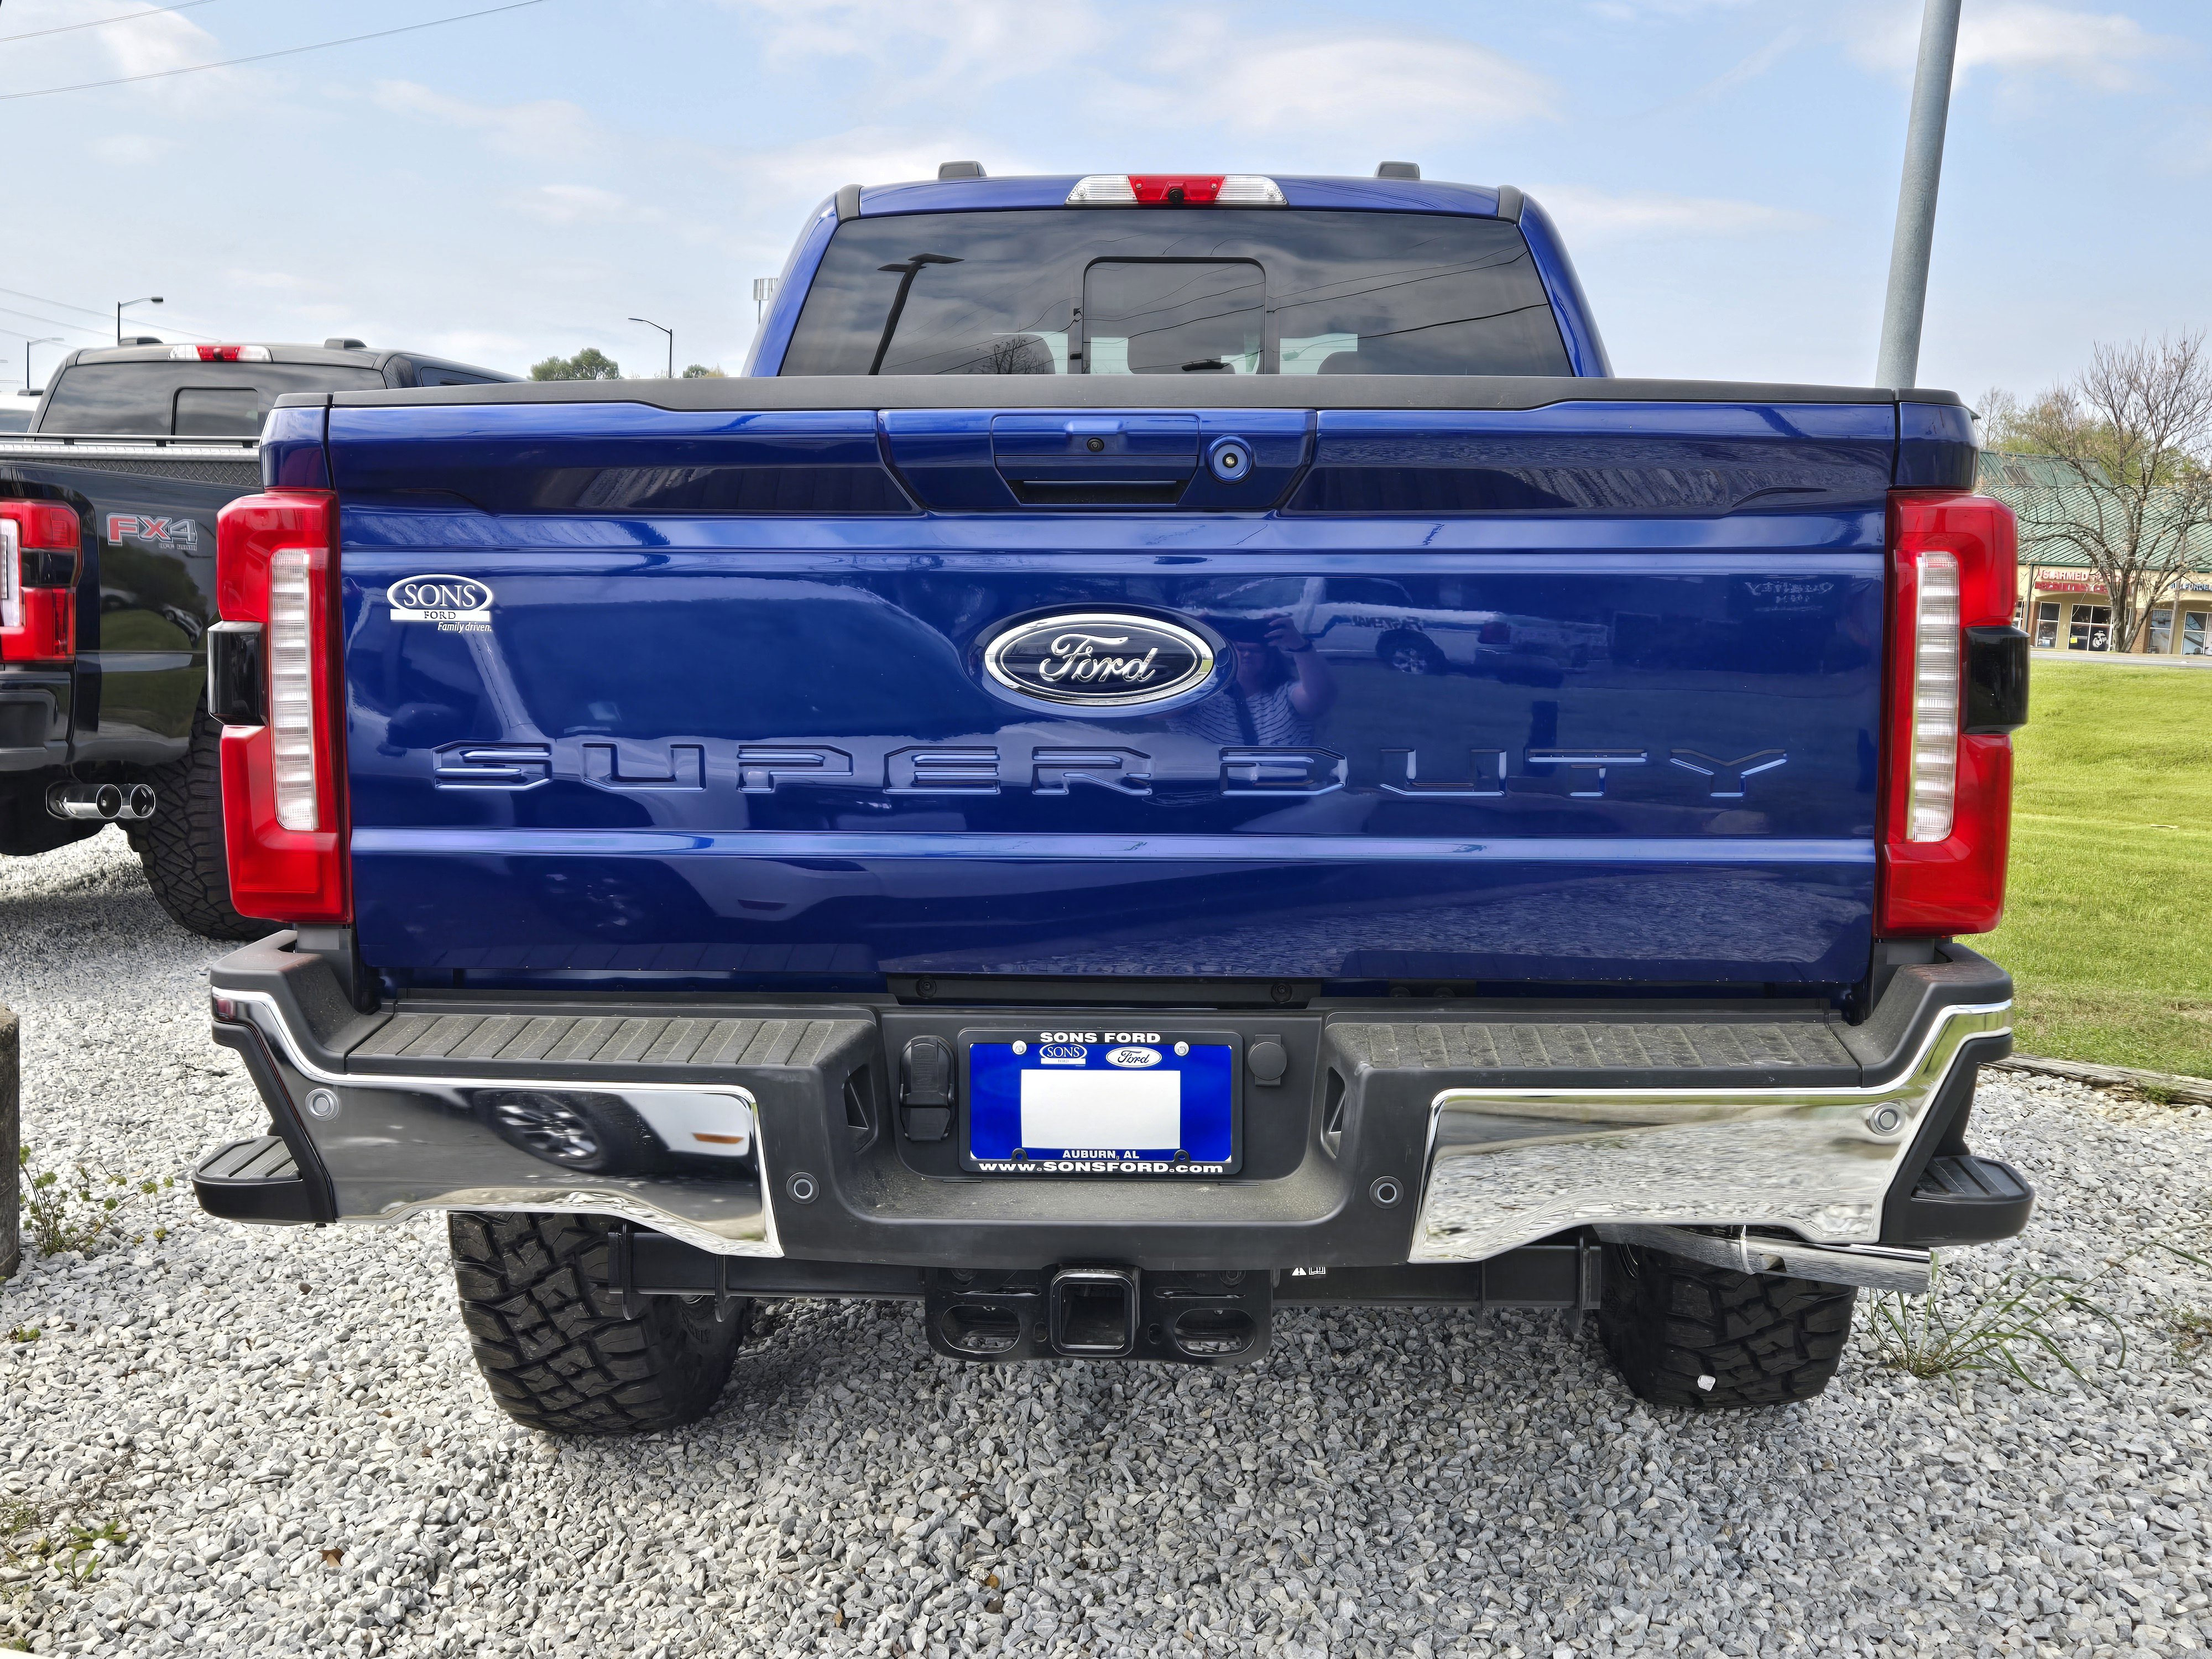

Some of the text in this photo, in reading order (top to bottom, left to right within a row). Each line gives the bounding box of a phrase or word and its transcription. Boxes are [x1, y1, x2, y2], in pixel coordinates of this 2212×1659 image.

[107, 513, 197, 546] FX4
[2054, 570, 2089, 581] ARMED
[403, 583, 476, 607] SONS
[424, 611, 456, 619] FORD
[437, 622, 465, 633] Family
[1039, 633, 1159, 682] Ford
[434, 741, 1788, 797] SUPER DUTY
[1040, 1032, 1161, 1043] SONS FORD
[1046, 1046, 1150, 1064] SONS Ford
[1062, 1150, 1140, 1160] AUBURN, AL
[978, 1161, 1223, 1173] www.SONSFORD.com
